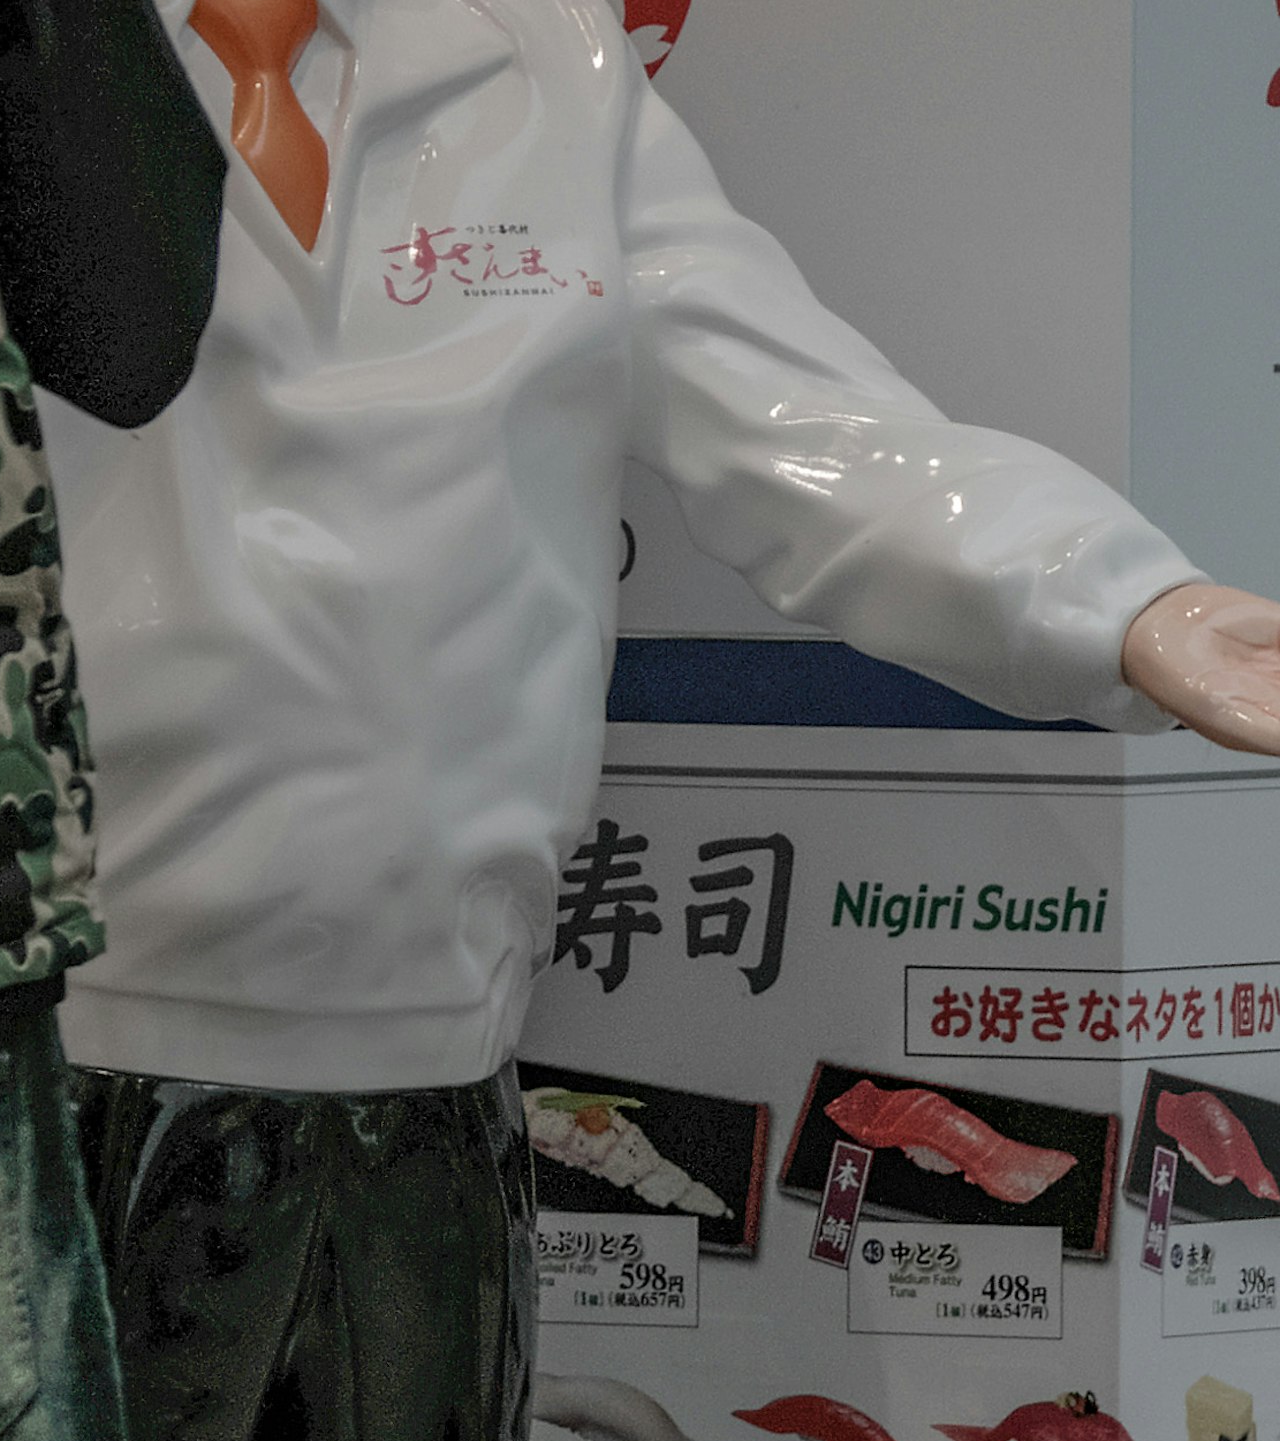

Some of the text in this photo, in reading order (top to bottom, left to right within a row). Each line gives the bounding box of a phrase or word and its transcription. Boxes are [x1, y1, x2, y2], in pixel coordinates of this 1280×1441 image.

[552, 817, 794, 995] 寿司
[830, 881, 1107, 944] Nigiri Sushi
[889, 1241, 958, 1267] 中とろ
[620, 1263, 683, 1293] 598円
[889, 1286, 917, 1298] Tuna
[982, 1274, 1047, 1304] 498円
[1238, 1267, 1275, 1294] 398円
